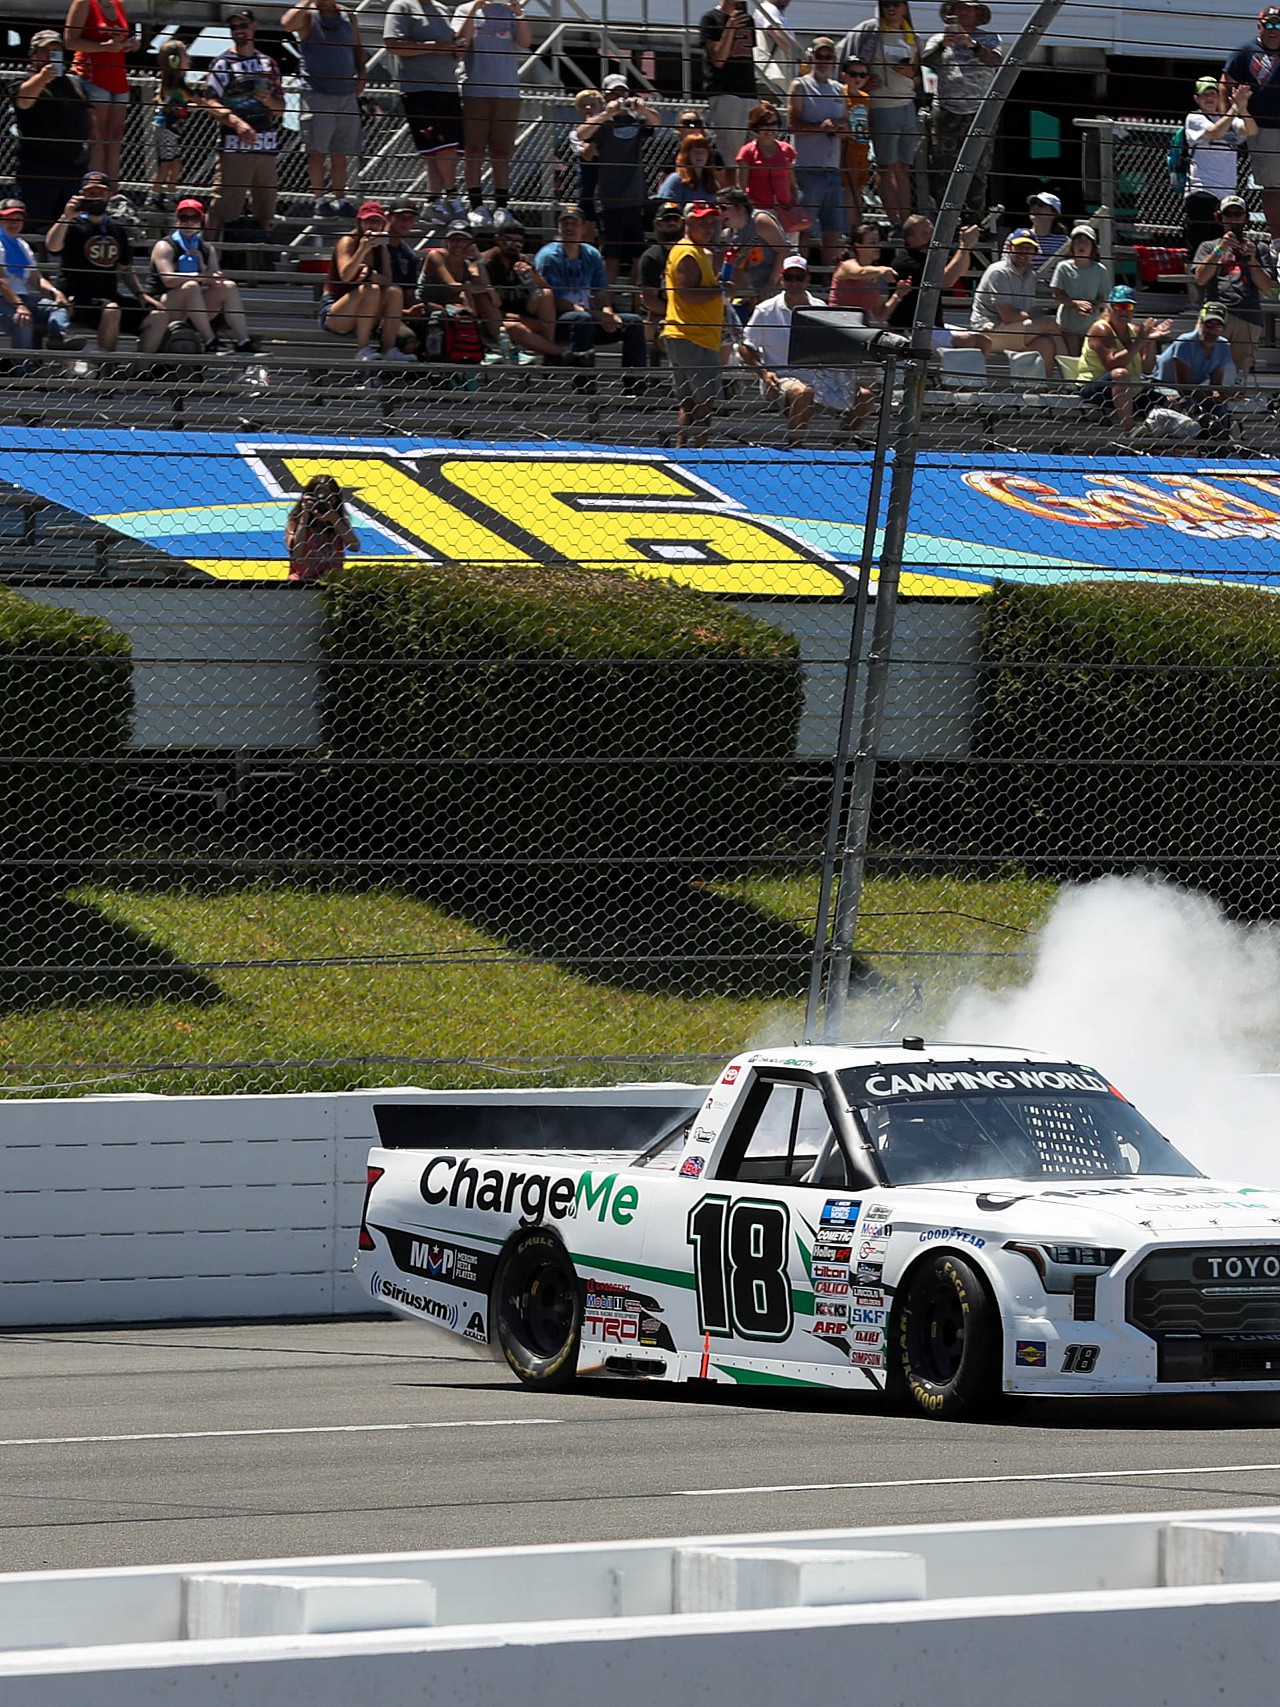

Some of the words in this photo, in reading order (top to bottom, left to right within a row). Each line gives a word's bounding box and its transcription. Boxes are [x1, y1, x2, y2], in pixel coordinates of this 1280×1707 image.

[865, 1071, 1015, 1096] CAMPING
[1008, 1070, 1109, 1093] WORLD
[419, 1155, 639, 1227] ChargeMe
[817, 1230, 853, 1242] COMETIC
[919, 1227, 986, 1249] GOODYEAR
[813, 1245, 836, 1261] Holley
[686, 1194, 795, 1343] 18
[814, 1265, 848, 1280] tilton
[943, 1261, 970, 1313] EAGLE
[852, 1308, 885, 1324] SKF
[586, 1316, 638, 1344] TRD
[813, 1321, 848, 1335] ARP
[851, 1351, 883, 1366] SIMPSON
[1060, 1343, 1102, 1375] 18
